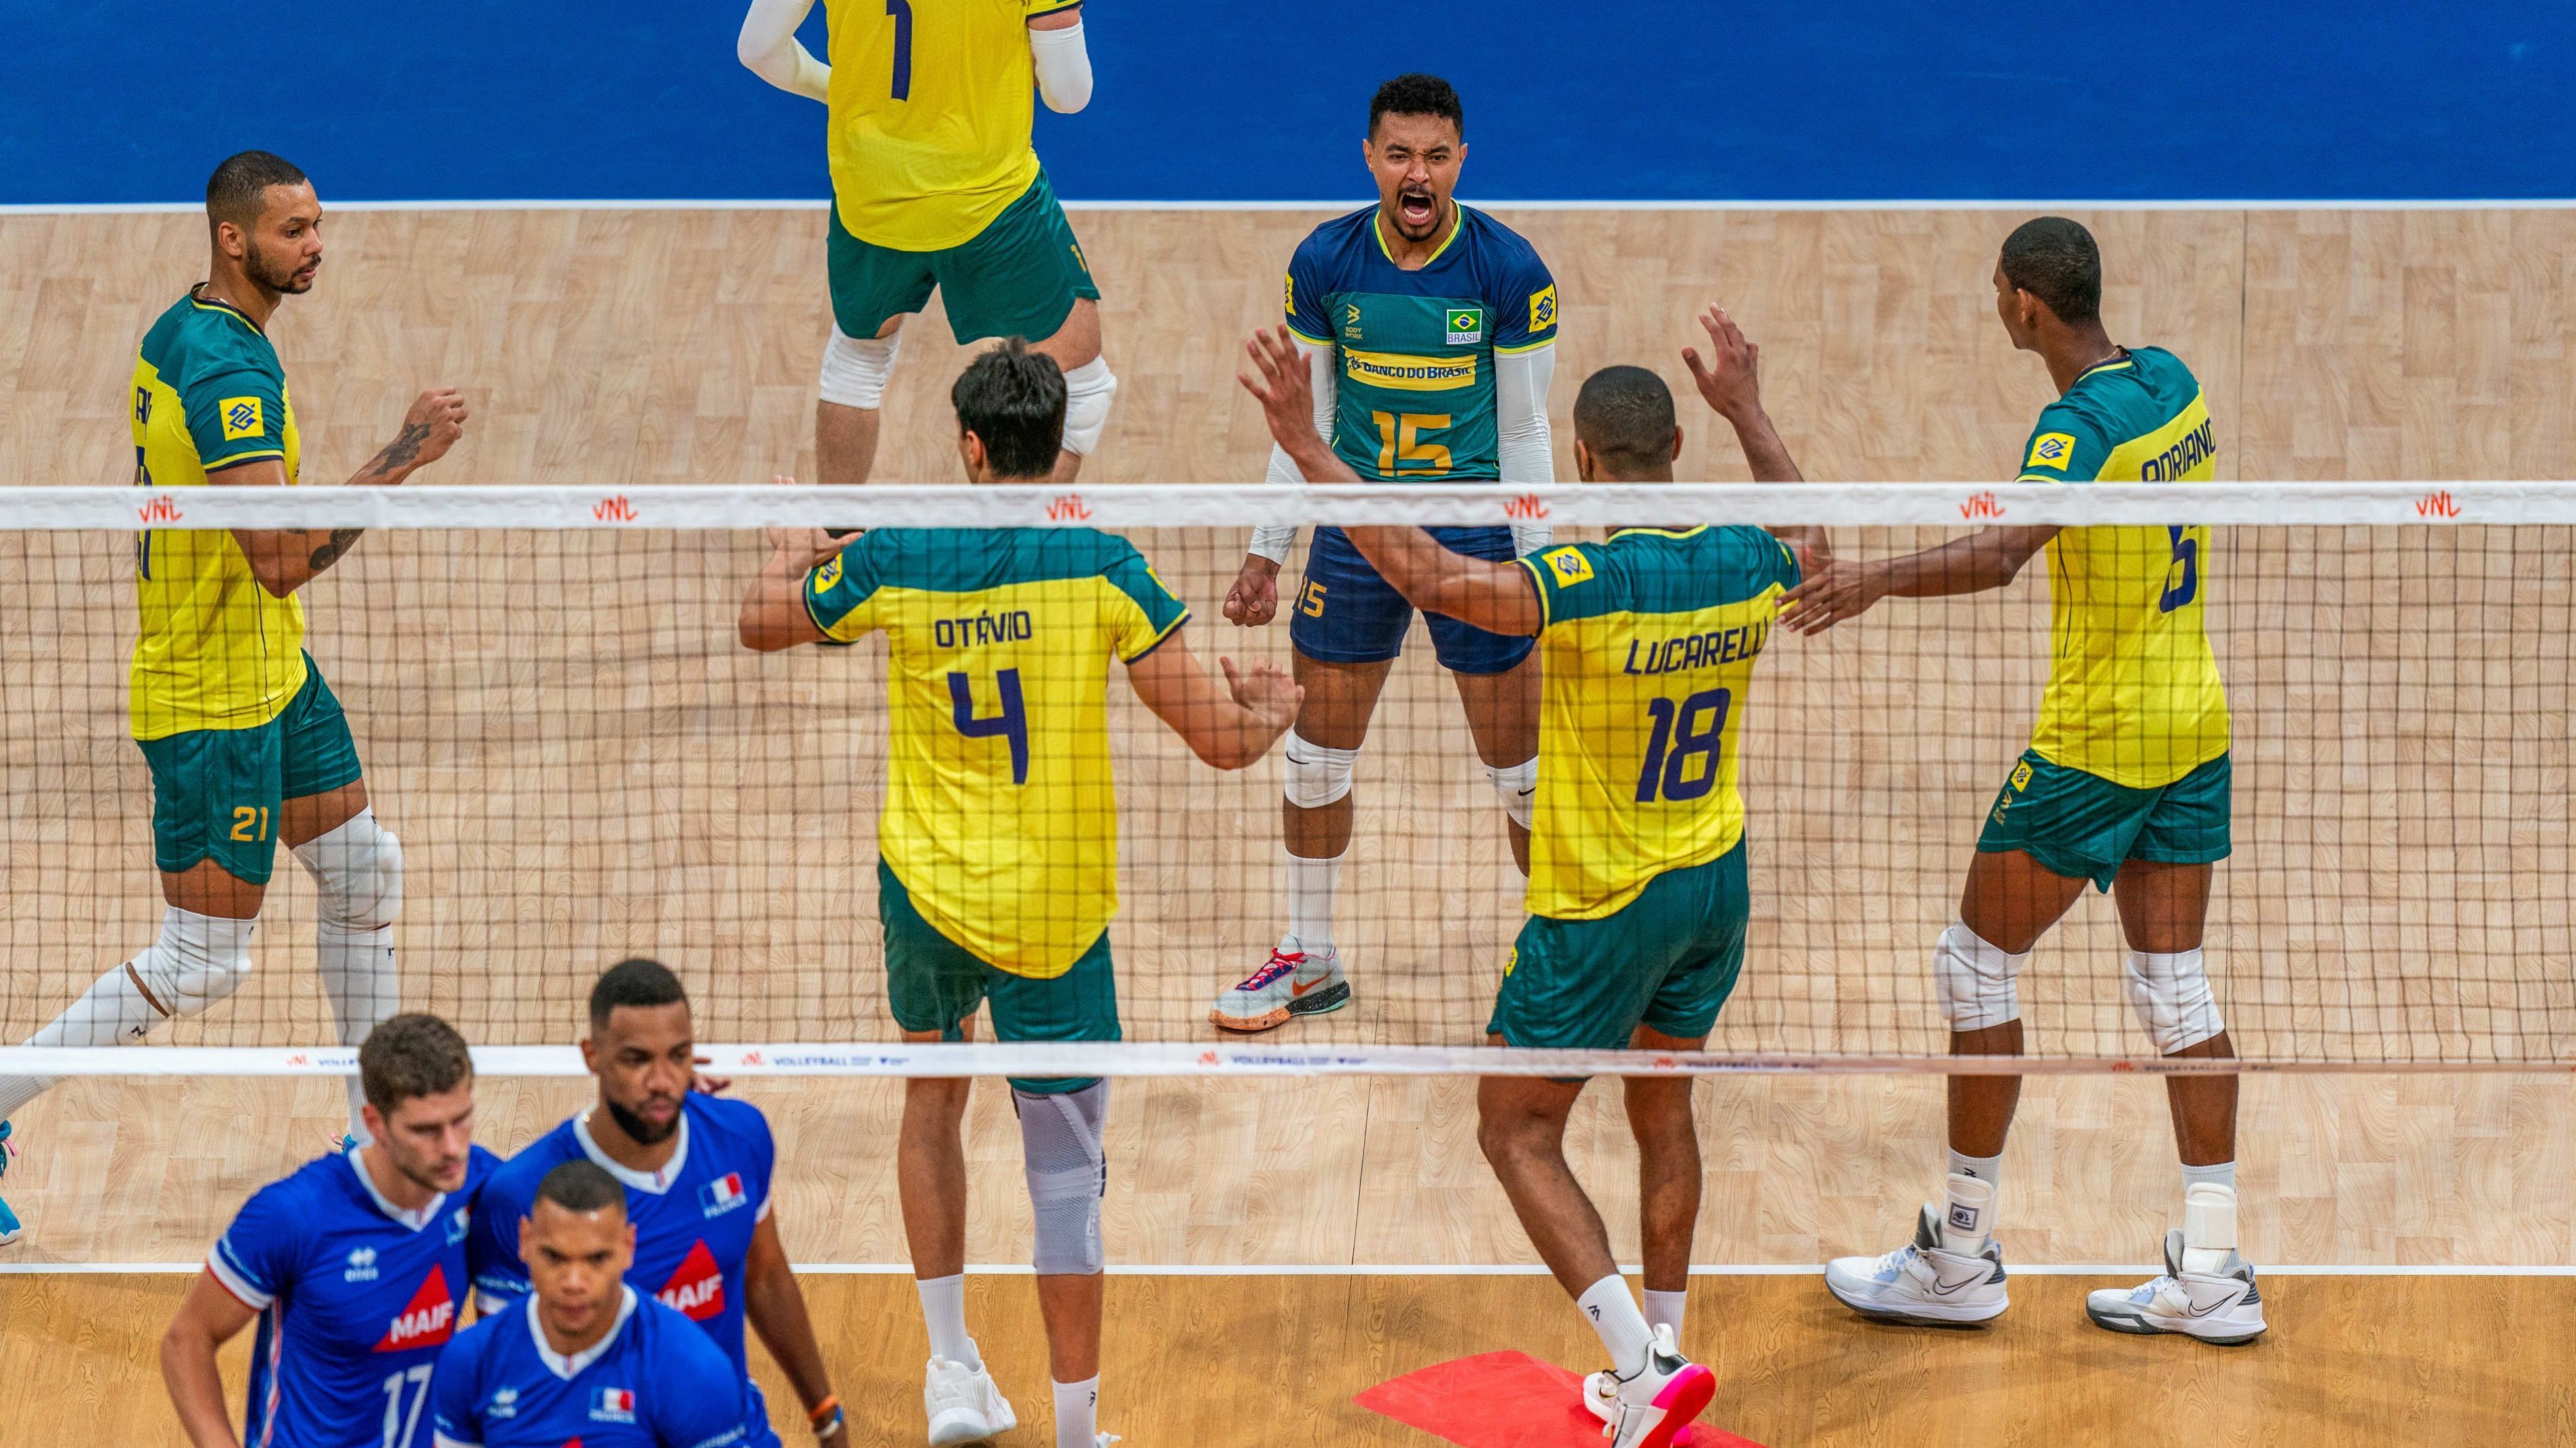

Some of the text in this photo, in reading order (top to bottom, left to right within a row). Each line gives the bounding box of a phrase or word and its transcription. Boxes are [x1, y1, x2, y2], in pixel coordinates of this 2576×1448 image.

[885, 0, 913, 103] 1
[1448, 332, 1480, 342] BRASIL
[1363, 361, 1471, 379] BANCO DO BRASIL
[1372, 410, 1453, 477] 15
[139, 495, 183, 523] VNL
[592, 494, 639, 522] VNL
[1046, 494, 1092, 521] VNL
[1503, 492, 1550, 520] VNL
[1960, 491, 2006, 519] VNL
[2416, 490, 2461, 517] VNL
[1298, 576, 1327, 617] 15
[935, 609, 1031, 648] OTÁVIO
[947, 668, 1028, 785] 4
[1635, 688, 1731, 802] 18
[230, 807, 268, 842] 21
[390, 1301, 454, 1343] MAIF
[382, 1363, 433, 1448] 17
